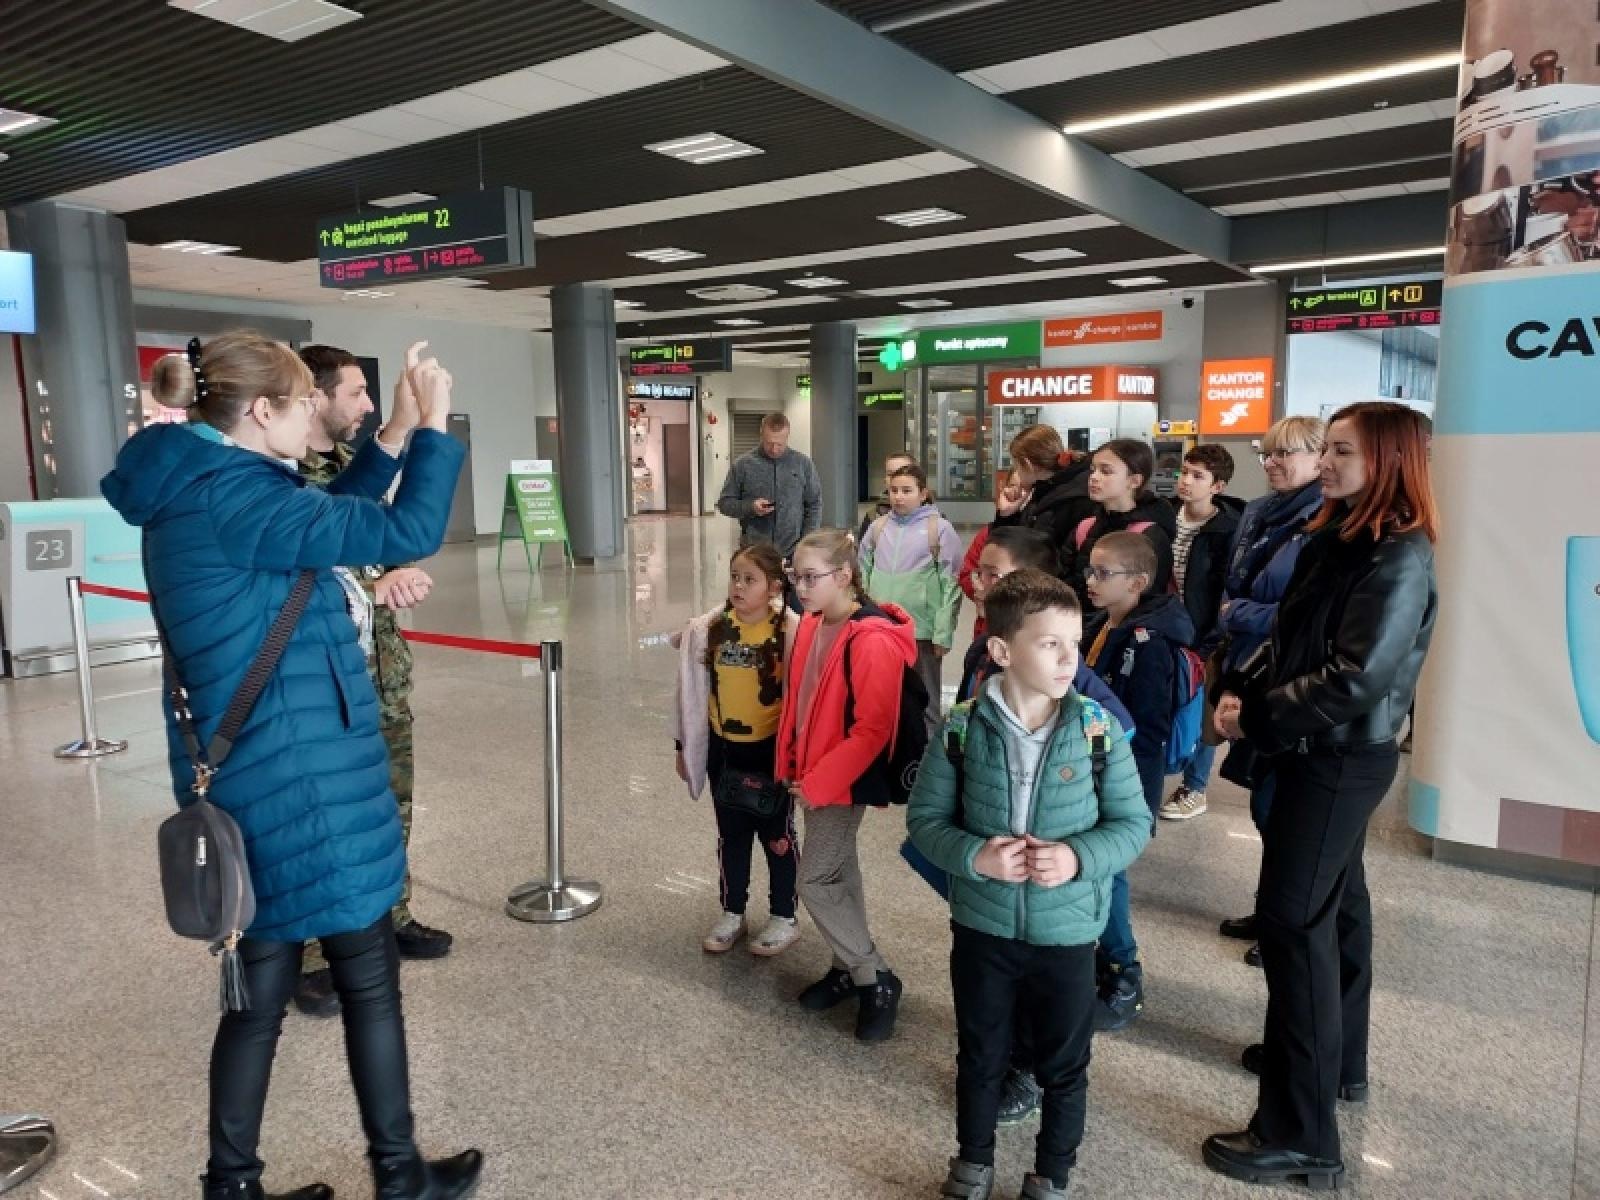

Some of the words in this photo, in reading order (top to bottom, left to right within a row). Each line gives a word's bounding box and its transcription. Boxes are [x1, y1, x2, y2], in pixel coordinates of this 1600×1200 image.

[434, 208, 449, 228] 22
[1506, 318, 1600, 360] CA
[1001, 374, 1093, 398] CHANGE
[1117, 374, 1155, 395] KANTOR
[1207, 371, 1265, 385] KANTOR
[1207, 386, 1265, 401] CHANGE
[35, 540, 65, 561] 23
